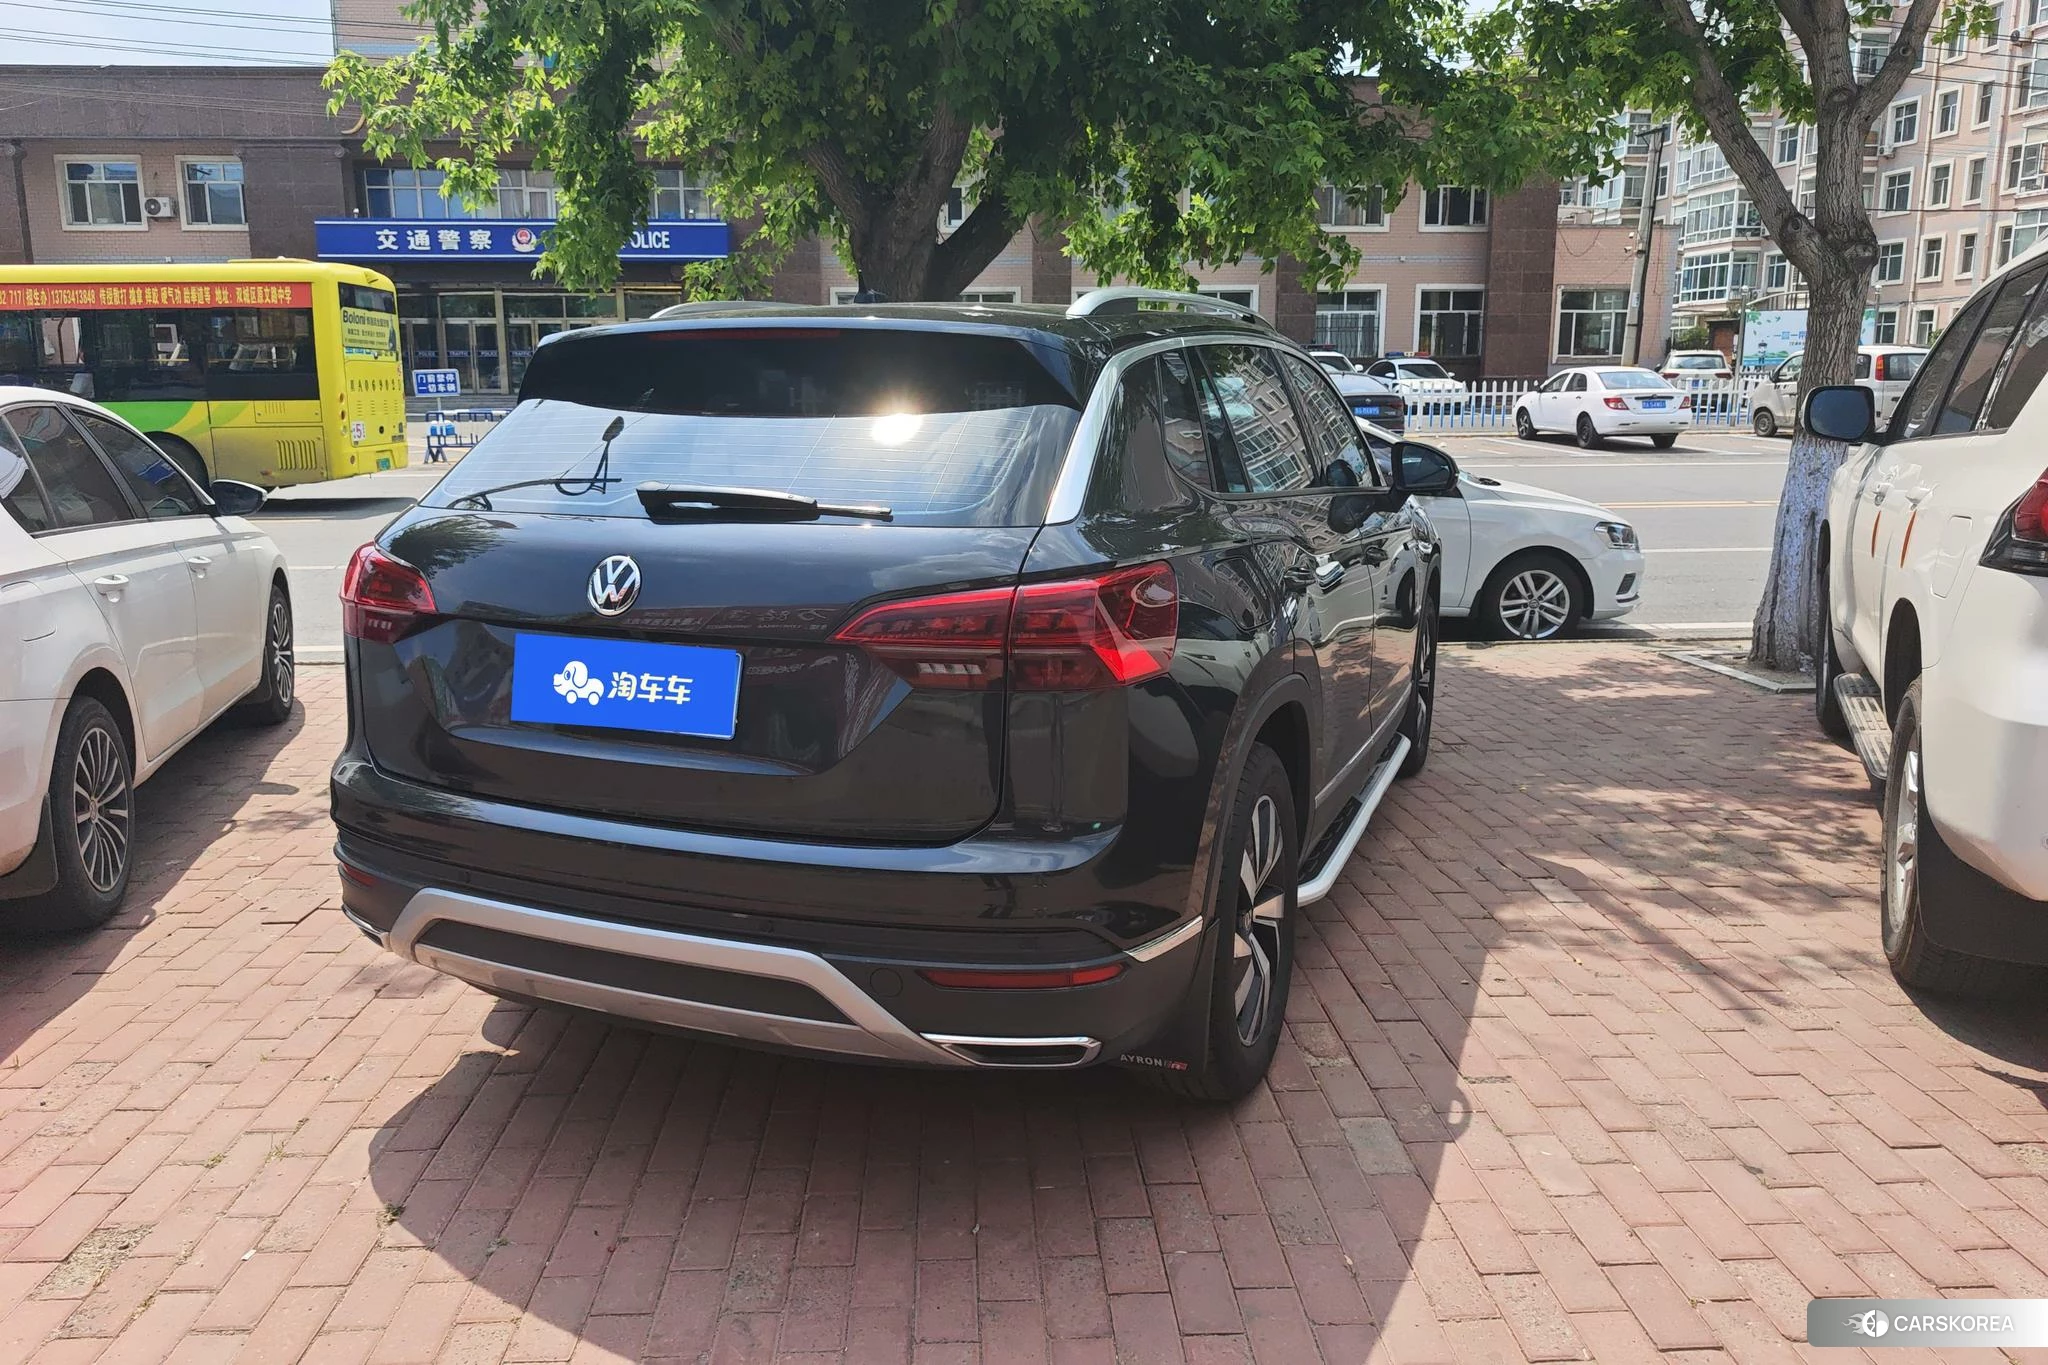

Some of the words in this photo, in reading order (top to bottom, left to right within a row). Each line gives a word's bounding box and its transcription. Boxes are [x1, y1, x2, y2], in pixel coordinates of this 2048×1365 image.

[376, 229, 492, 250] 交通警察
[622, 231, 670, 249] OLICE
[343, 310, 366, 325] Boloni
